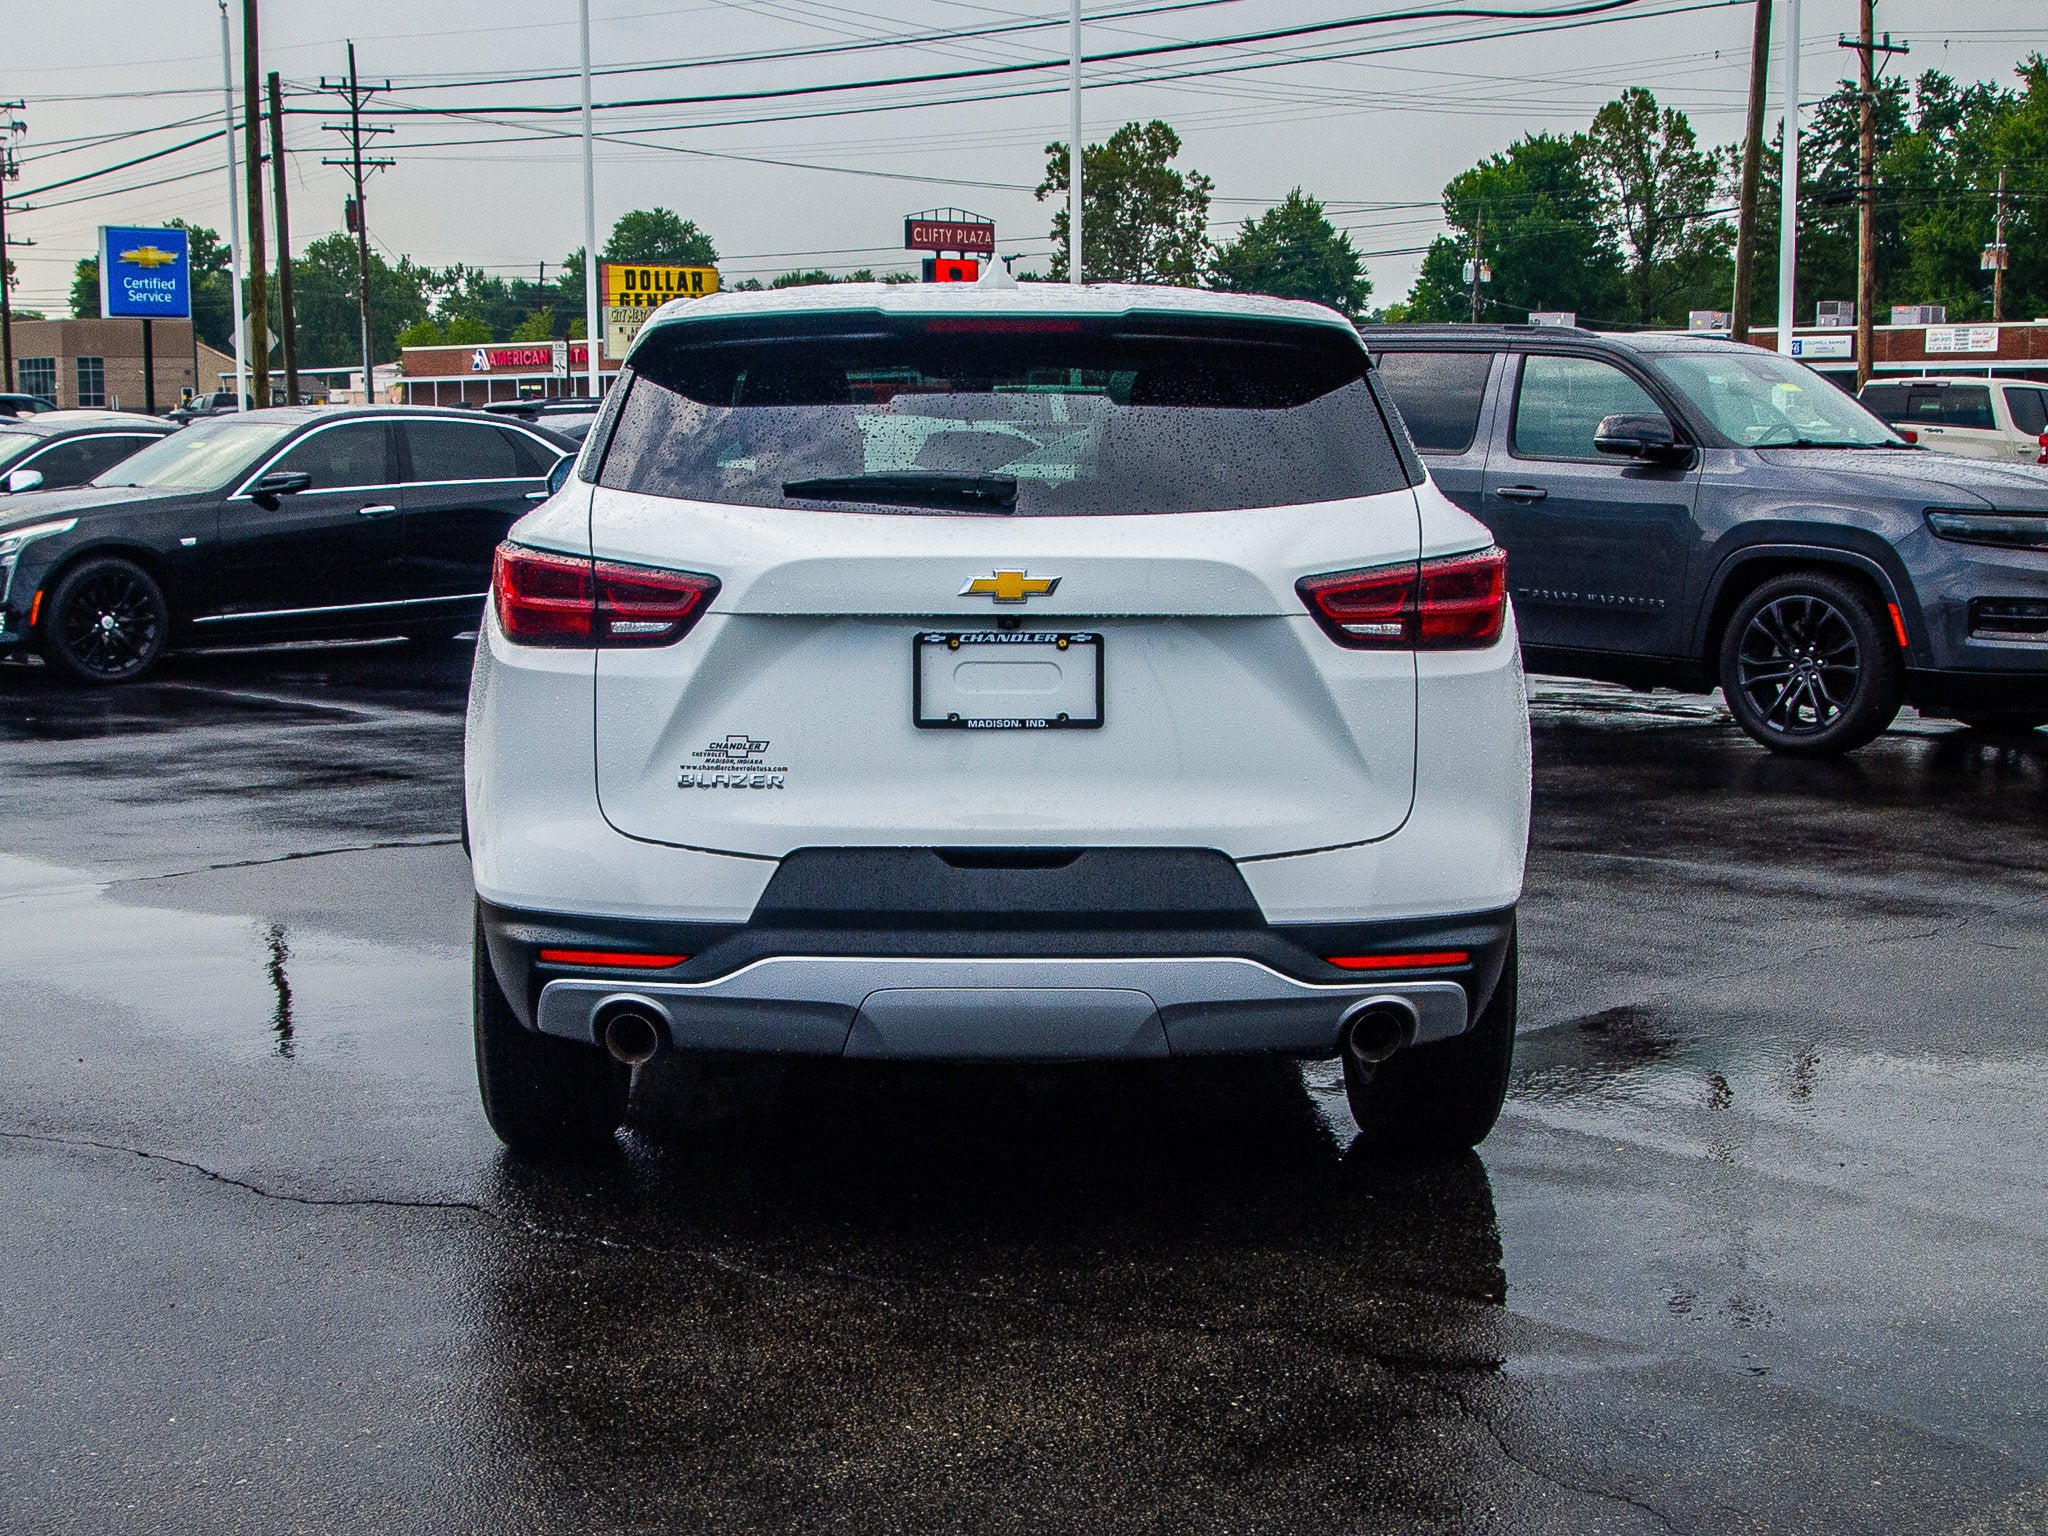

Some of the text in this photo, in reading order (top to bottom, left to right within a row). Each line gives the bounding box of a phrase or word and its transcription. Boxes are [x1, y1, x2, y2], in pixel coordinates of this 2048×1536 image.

[913, 227, 992, 245] CLIFTY PLAZA
[123, 277, 176, 290] Certified
[624, 269, 703, 292] DOLLAR
[128, 289, 172, 302] Service
[489, 350, 549, 366] AMERICAN
[959, 633, 1059, 643] CHANDLER
[1025, 719, 1049, 729] IND.
[709, 742, 761, 750] CHANDLER
[691, 750, 726, 758] CHEVROLET
[704, 757, 736, 765] MADISON,
[680, 764, 788, 772] www.chandlerchevroletusa.com
[677, 772, 784, 789] BLAZER
